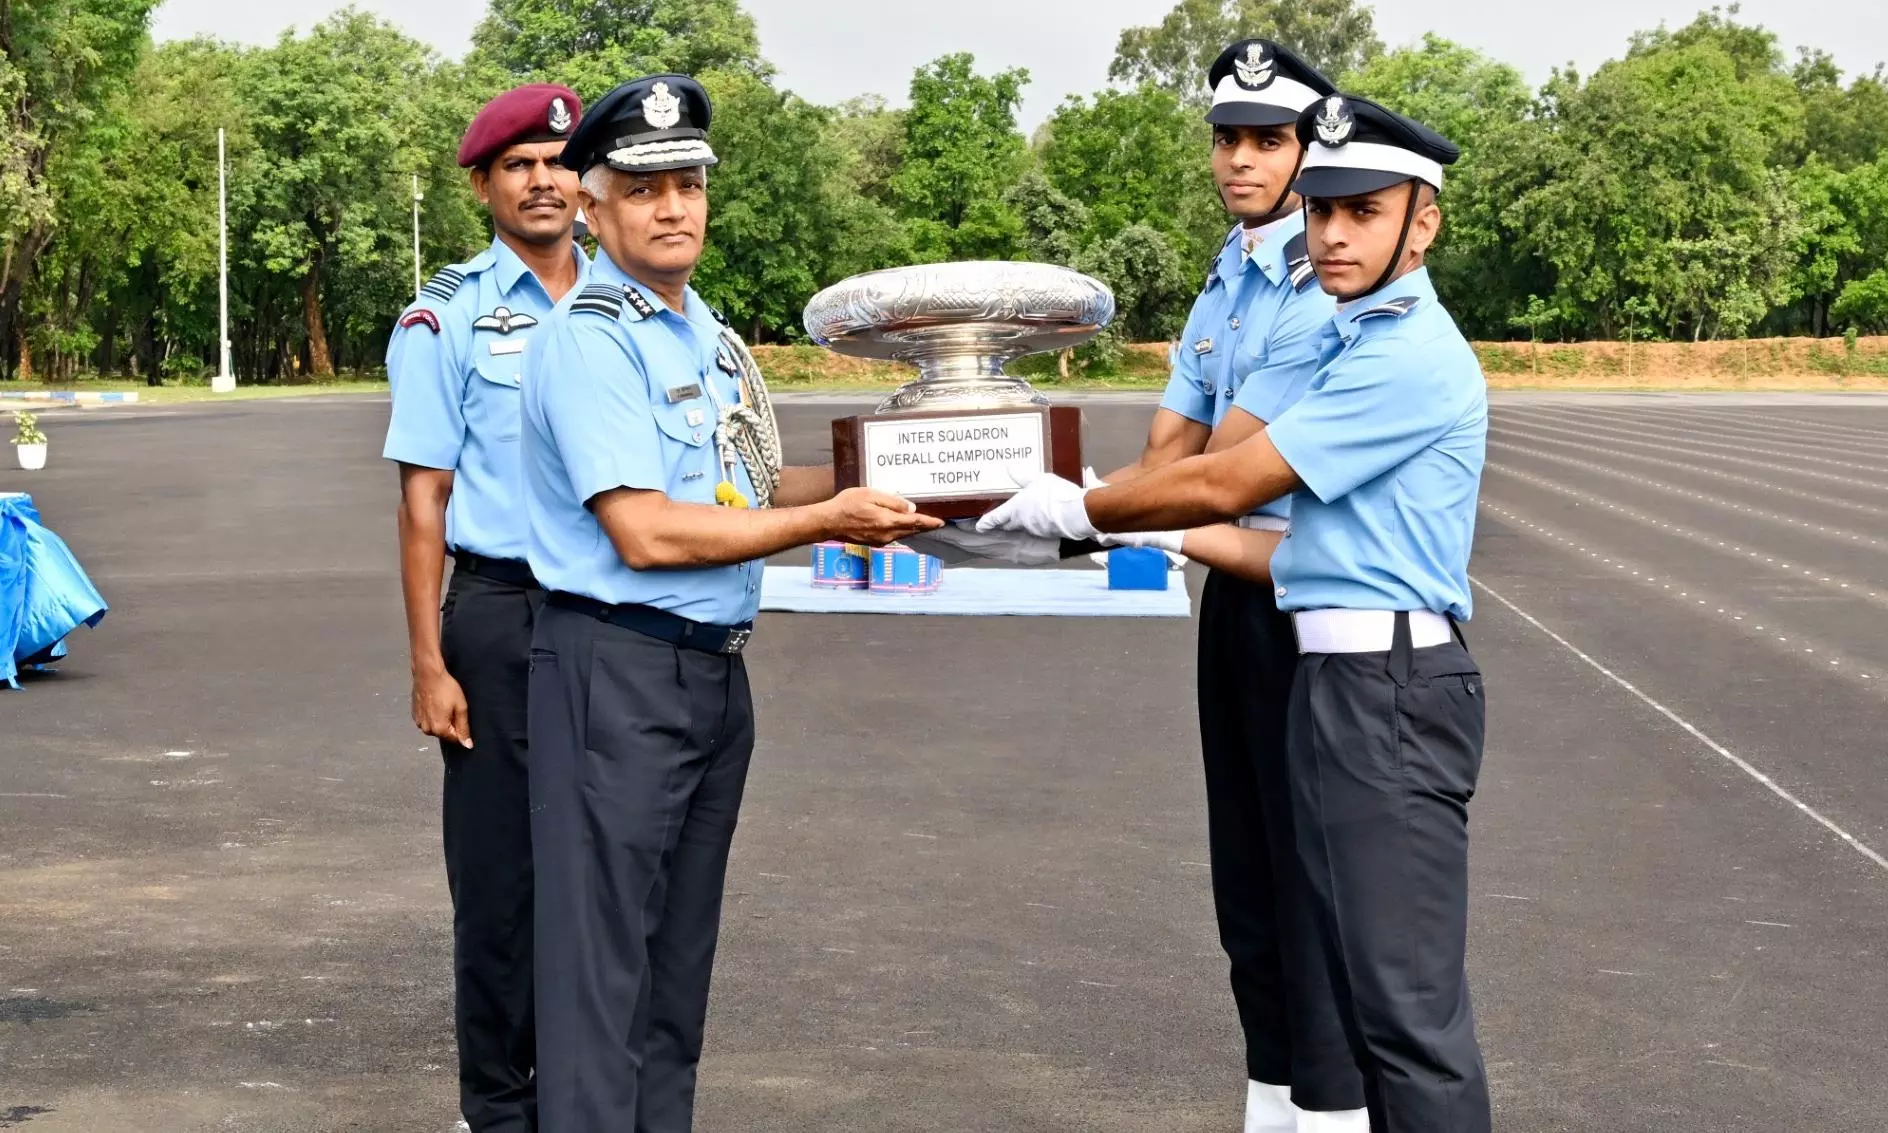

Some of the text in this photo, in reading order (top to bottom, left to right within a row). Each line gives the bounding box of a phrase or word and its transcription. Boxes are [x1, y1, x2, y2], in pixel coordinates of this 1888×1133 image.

[898, 427, 1009, 445] INTER SQUADRON
[877, 447, 1033, 467] OVERALL CHAMPIONSHIP
[930, 470, 981, 484] TROPHY
